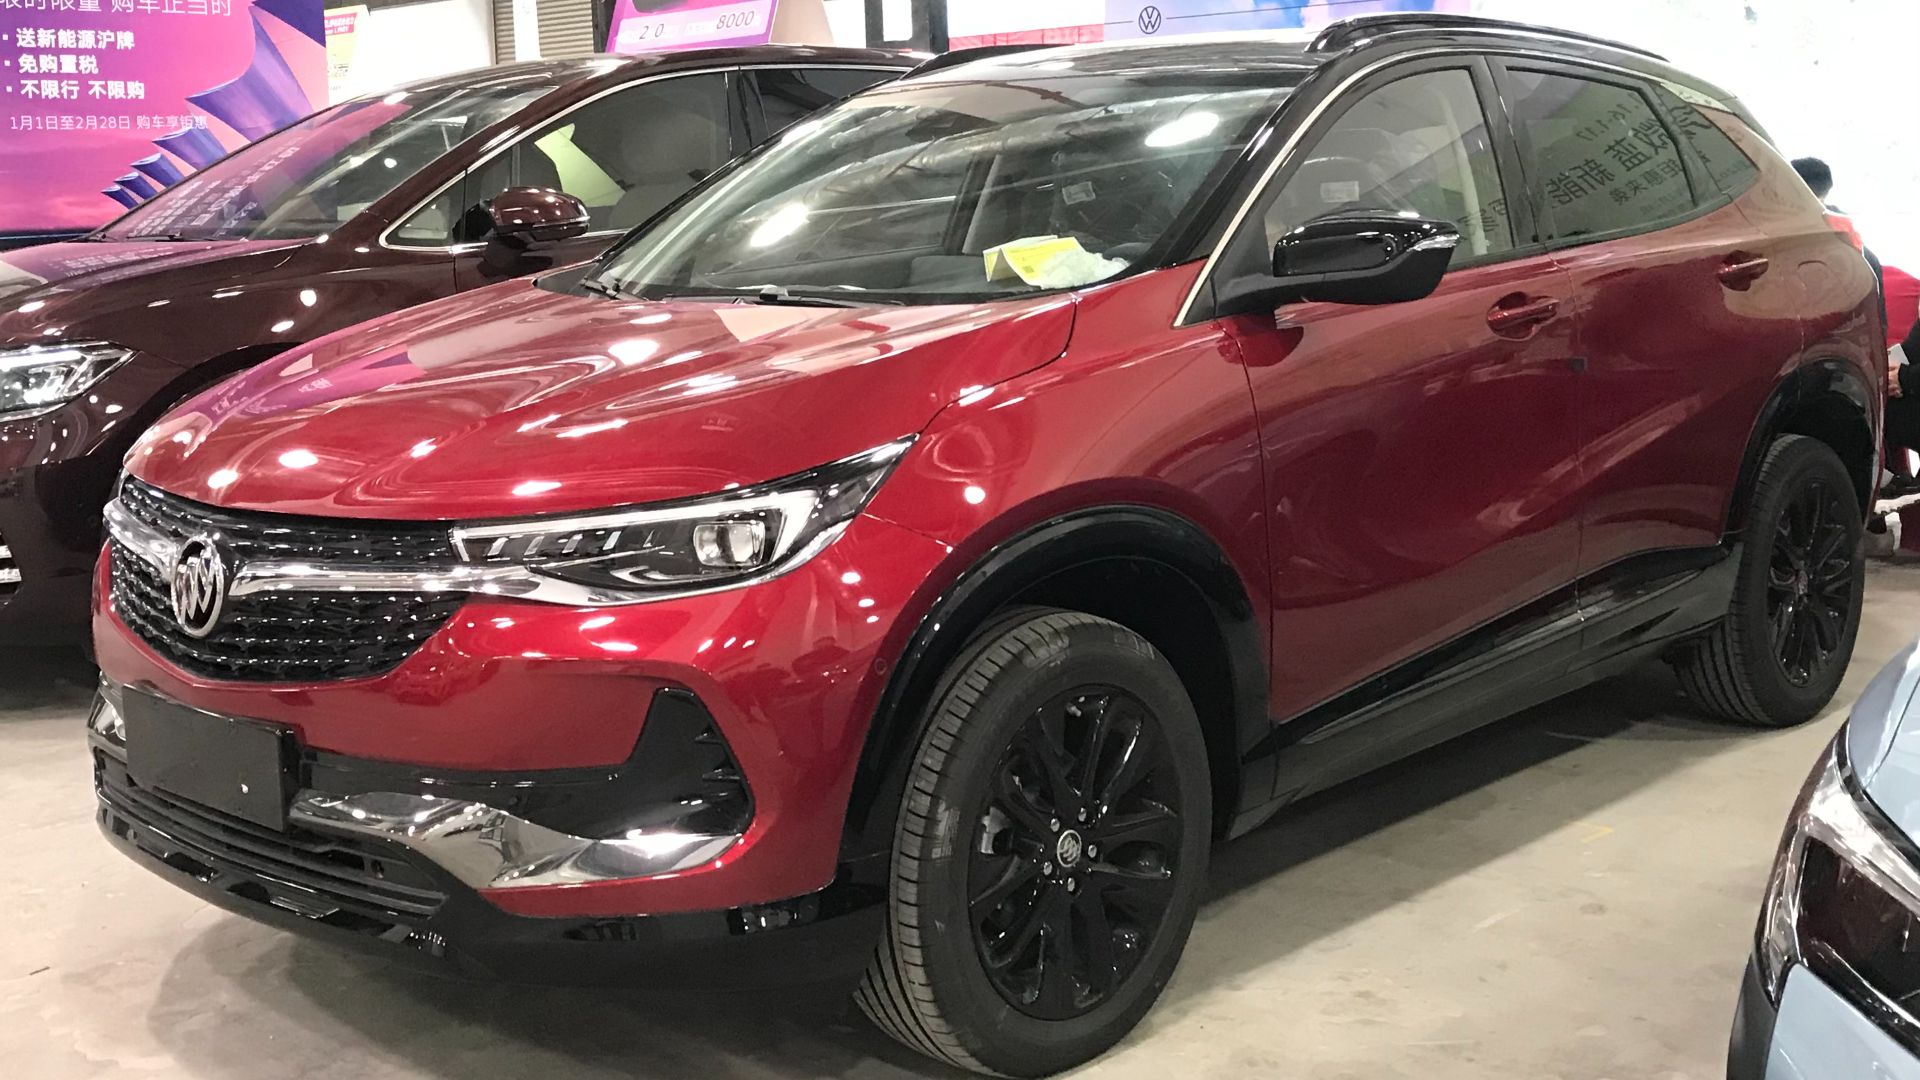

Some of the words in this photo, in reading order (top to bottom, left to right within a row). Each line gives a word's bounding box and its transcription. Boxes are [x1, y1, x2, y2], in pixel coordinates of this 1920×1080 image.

[716, 10, 755, 30] 8000
[16, 27, 135, 50] 送新能源沪牌
[18, 53, 99, 74] 免购置税
[20, 79, 80, 100] 不限行
[88, 80, 145, 100] 不限购
[10, 115, 131, 131] 1月1日至2月28日
